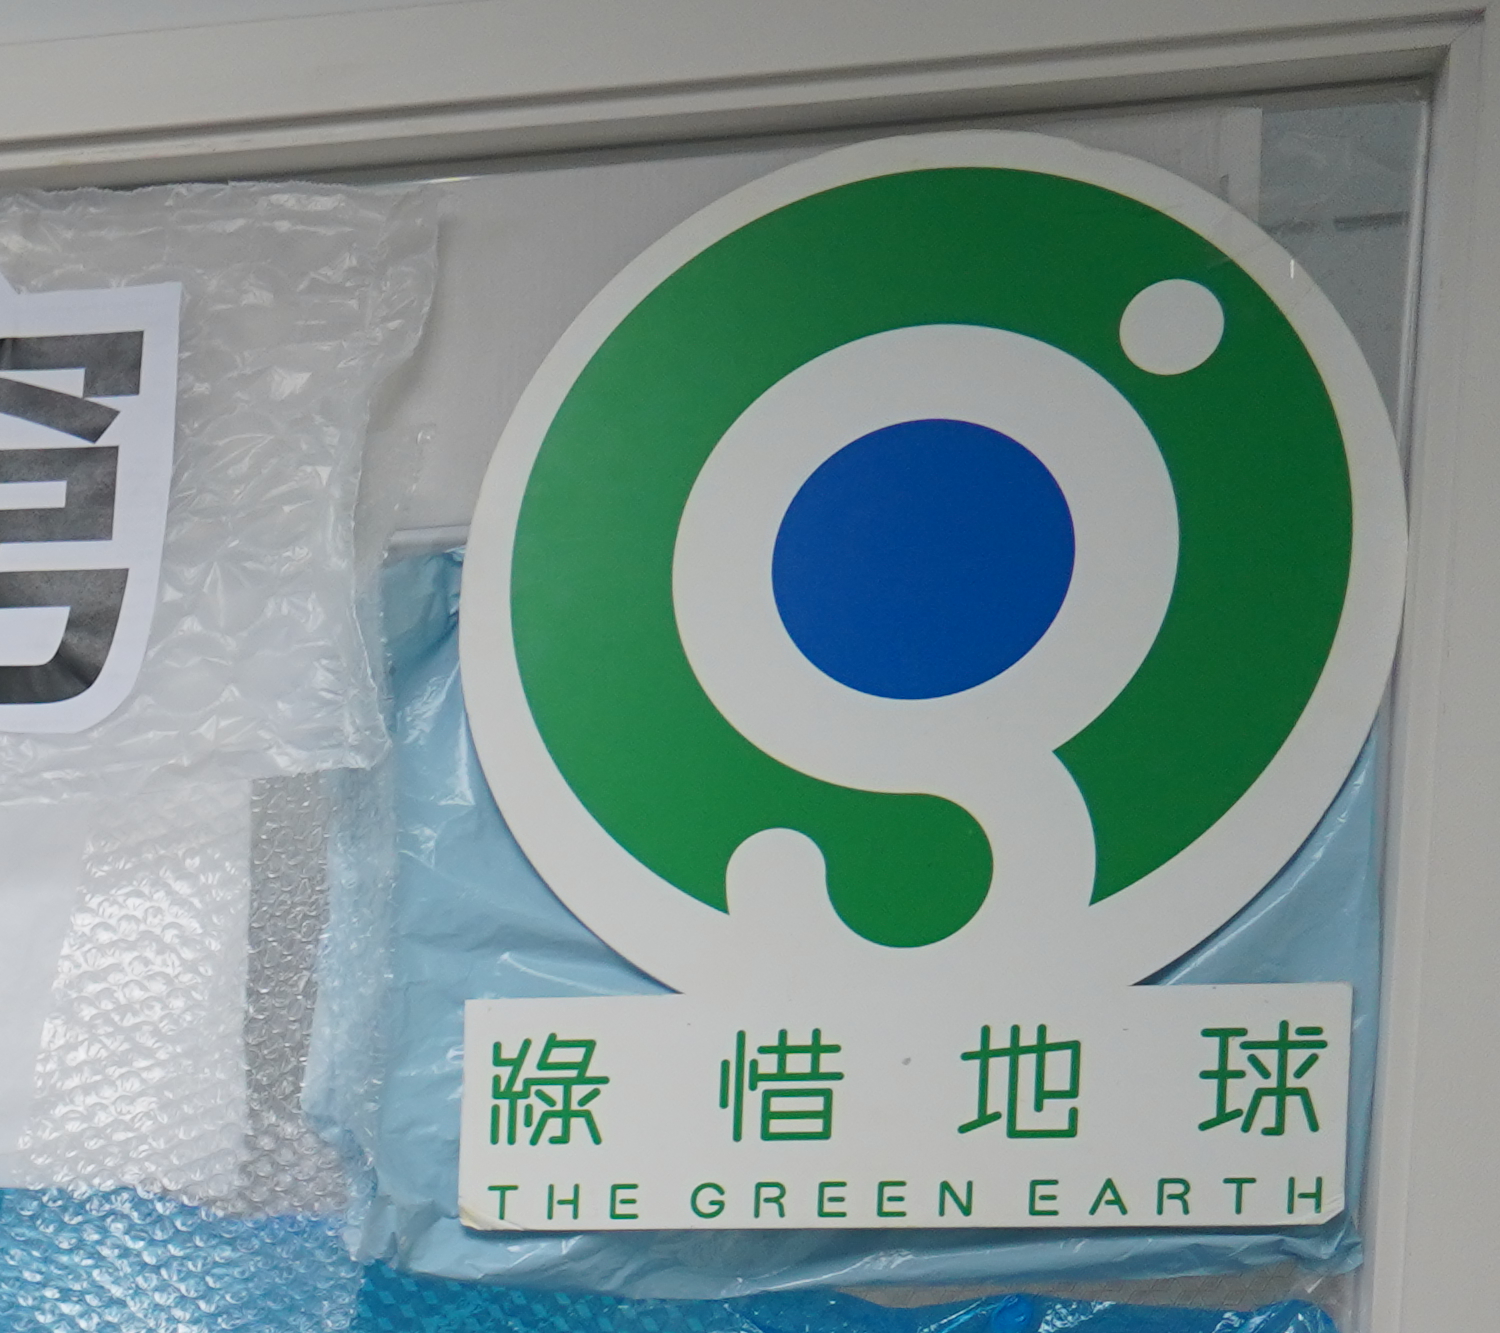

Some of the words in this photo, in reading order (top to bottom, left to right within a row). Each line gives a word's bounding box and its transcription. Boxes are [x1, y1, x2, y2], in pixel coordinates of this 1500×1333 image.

[490, 1019, 1328, 1146] 綠惜地球
[488, 1184, 639, 1221] THE
[690, 1180, 974, 1220] GREEN
[1028, 1176, 1324, 1217] EARTH
